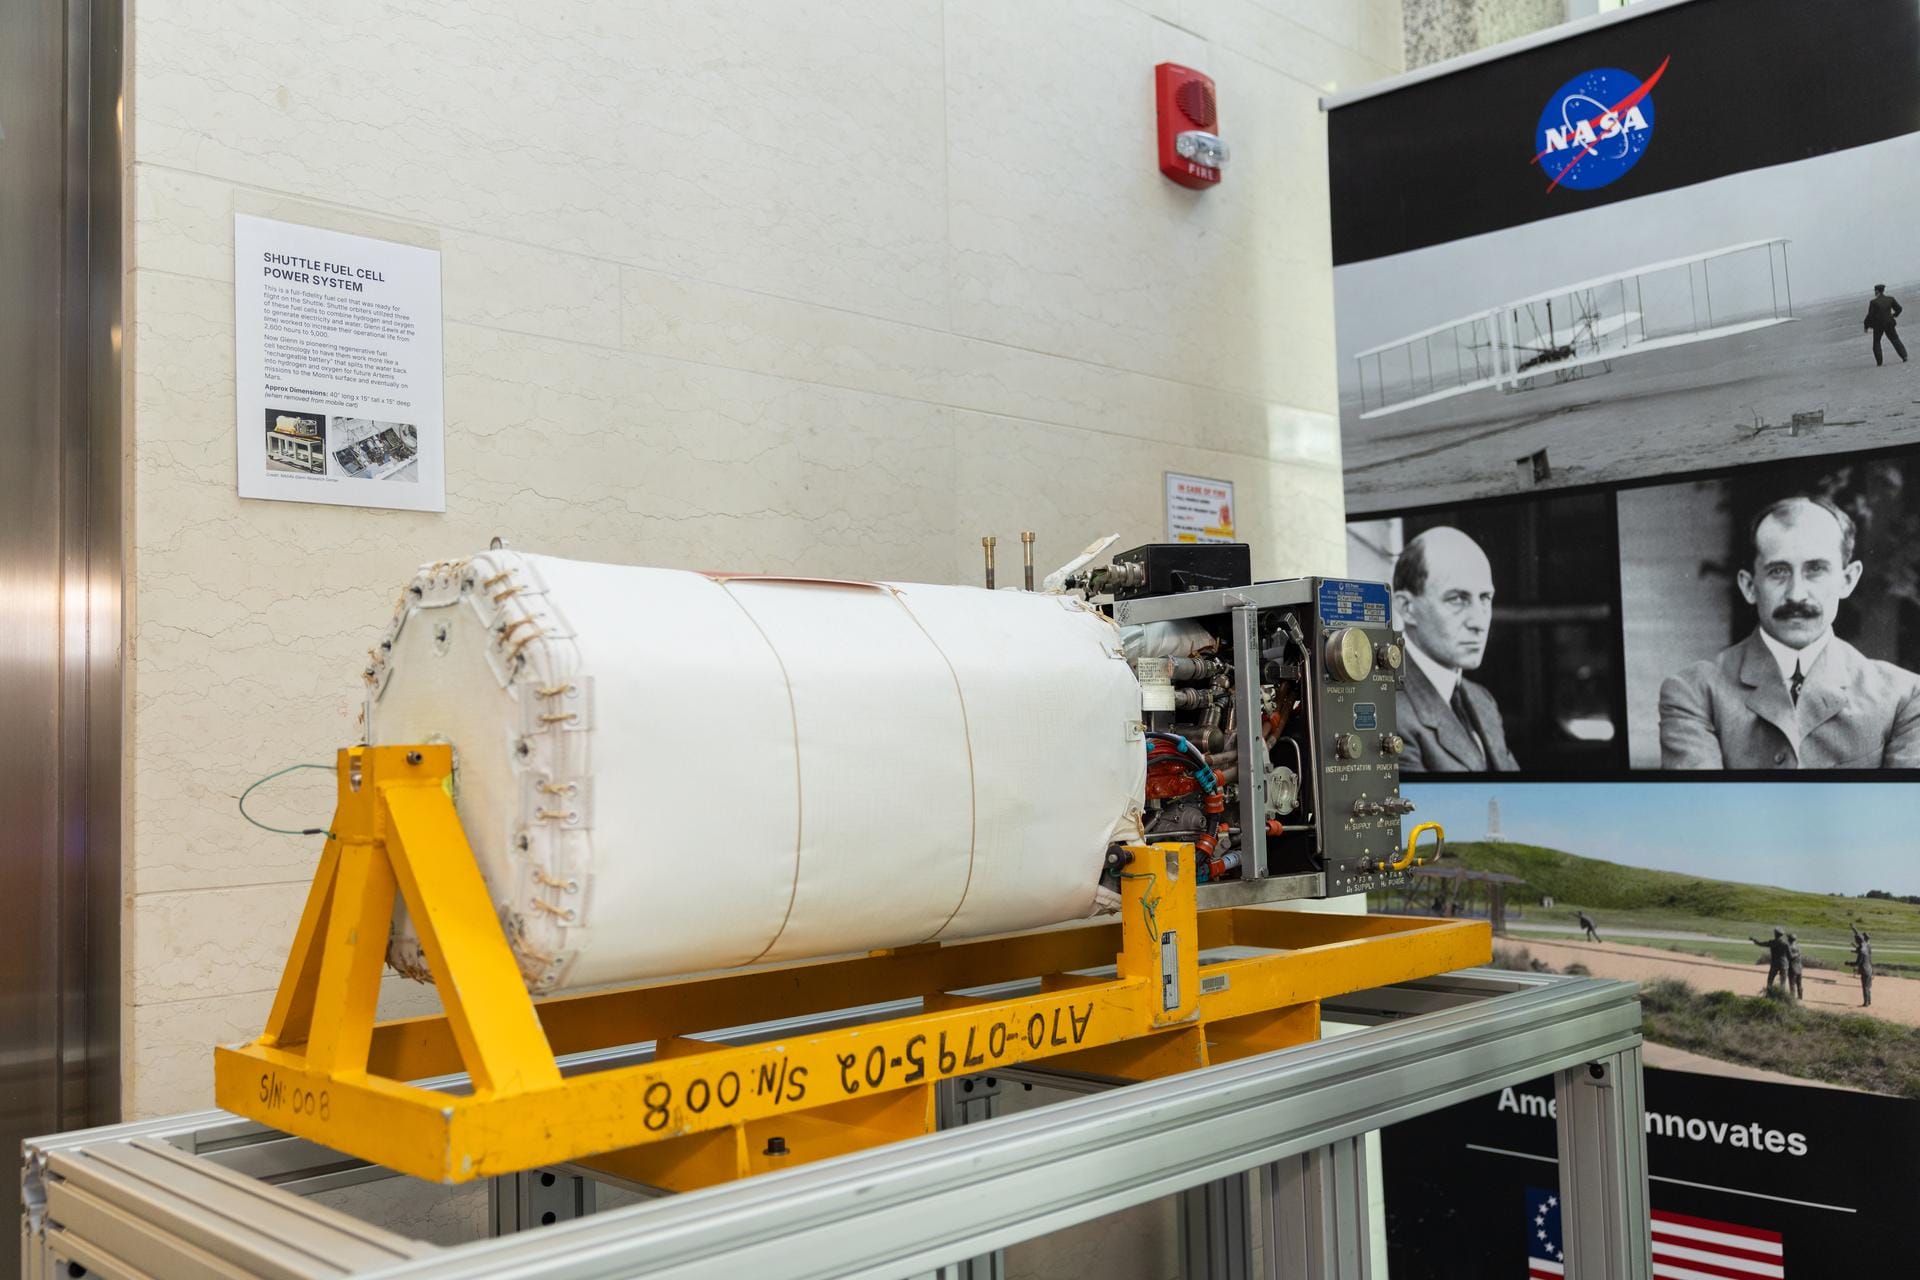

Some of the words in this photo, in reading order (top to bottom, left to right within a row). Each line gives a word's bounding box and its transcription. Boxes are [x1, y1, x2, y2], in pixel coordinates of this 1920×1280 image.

[1545, 106, 1648, 153] NASA
[264, 252, 320, 271] SHUTTLE
[325, 263, 353, 277] FUEL
[357, 268, 384, 282] CELL
[264, 267, 309, 284] POWER
[313, 275, 363, 292] SYSTEM
[264, 285, 277, 293] This
[291, 289, 322, 301] full-fidelity
[325, 294, 335, 302] fuel
[375, 302, 391, 312] ready
[264, 293, 280, 302] flight
[303, 298, 324, 307] Shuttle.
[327, 302, 347, 311] Shuttle
[350, 306, 371, 315] orbiters
[373, 309, 393, 318] utilized
[272, 301, 289, 310] these
[304, 306, 317, 314] cells
[327, 310, 352, 319] combine
[354, 314, 380, 325] hydrogen
[394, 321, 414, 330] oxygen
[272, 309, 299, 320] generate
[345, 320, 361, 328] water.
[364, 323, 380, 331] Glenn
[382, 326, 398, 335] (Lewis
[264, 316, 279, 325] time)
[281, 318, 302, 327] worked
[312, 323, 336, 332] increase
[354, 329, 385, 340] operational
[264, 324, 282, 333] 2,600
[284, 326, 301, 334] hours
[277, 344, 310, 355] technology
[306, 340, 337, 351] pioneering
[339, 345, 375, 356] regenerative
[265, 373, 281, 381] Mars.
[265, 366, 291, 374] missions
[313, 372, 333, 380] Moon's
[371, 379, 399, 389] eventually
[278, 360, 306, 370] hydrogen
[322, 367, 342, 375] oxygen
[354, 369, 371, 377] future
[373, 372, 394, 380] Artemis
[265, 392, 283, 401] (when
[284, 395, 309, 403] removed
[325, 399, 344, 407] mobile
[346, 401, 358, 410] cart)
[1326, 686, 1344, 694] POWER
[1345, 686, 1356, 694] OUT
[1372, 674, 1394, 682] CONTROL
[1352, 822, 1372, 830] SUPPLY
[1354, 882, 1375, 892] SUPPLY
[751, 1056, 809, 1105] S/N:
[259, 1071, 287, 1110] S/N:
[292, 1088, 330, 1122] 008
[643, 1071, 740, 1131] 008
[1497, 1086, 1557, 1119] Ame
[1645, 1110, 1808, 1157] nnovates
